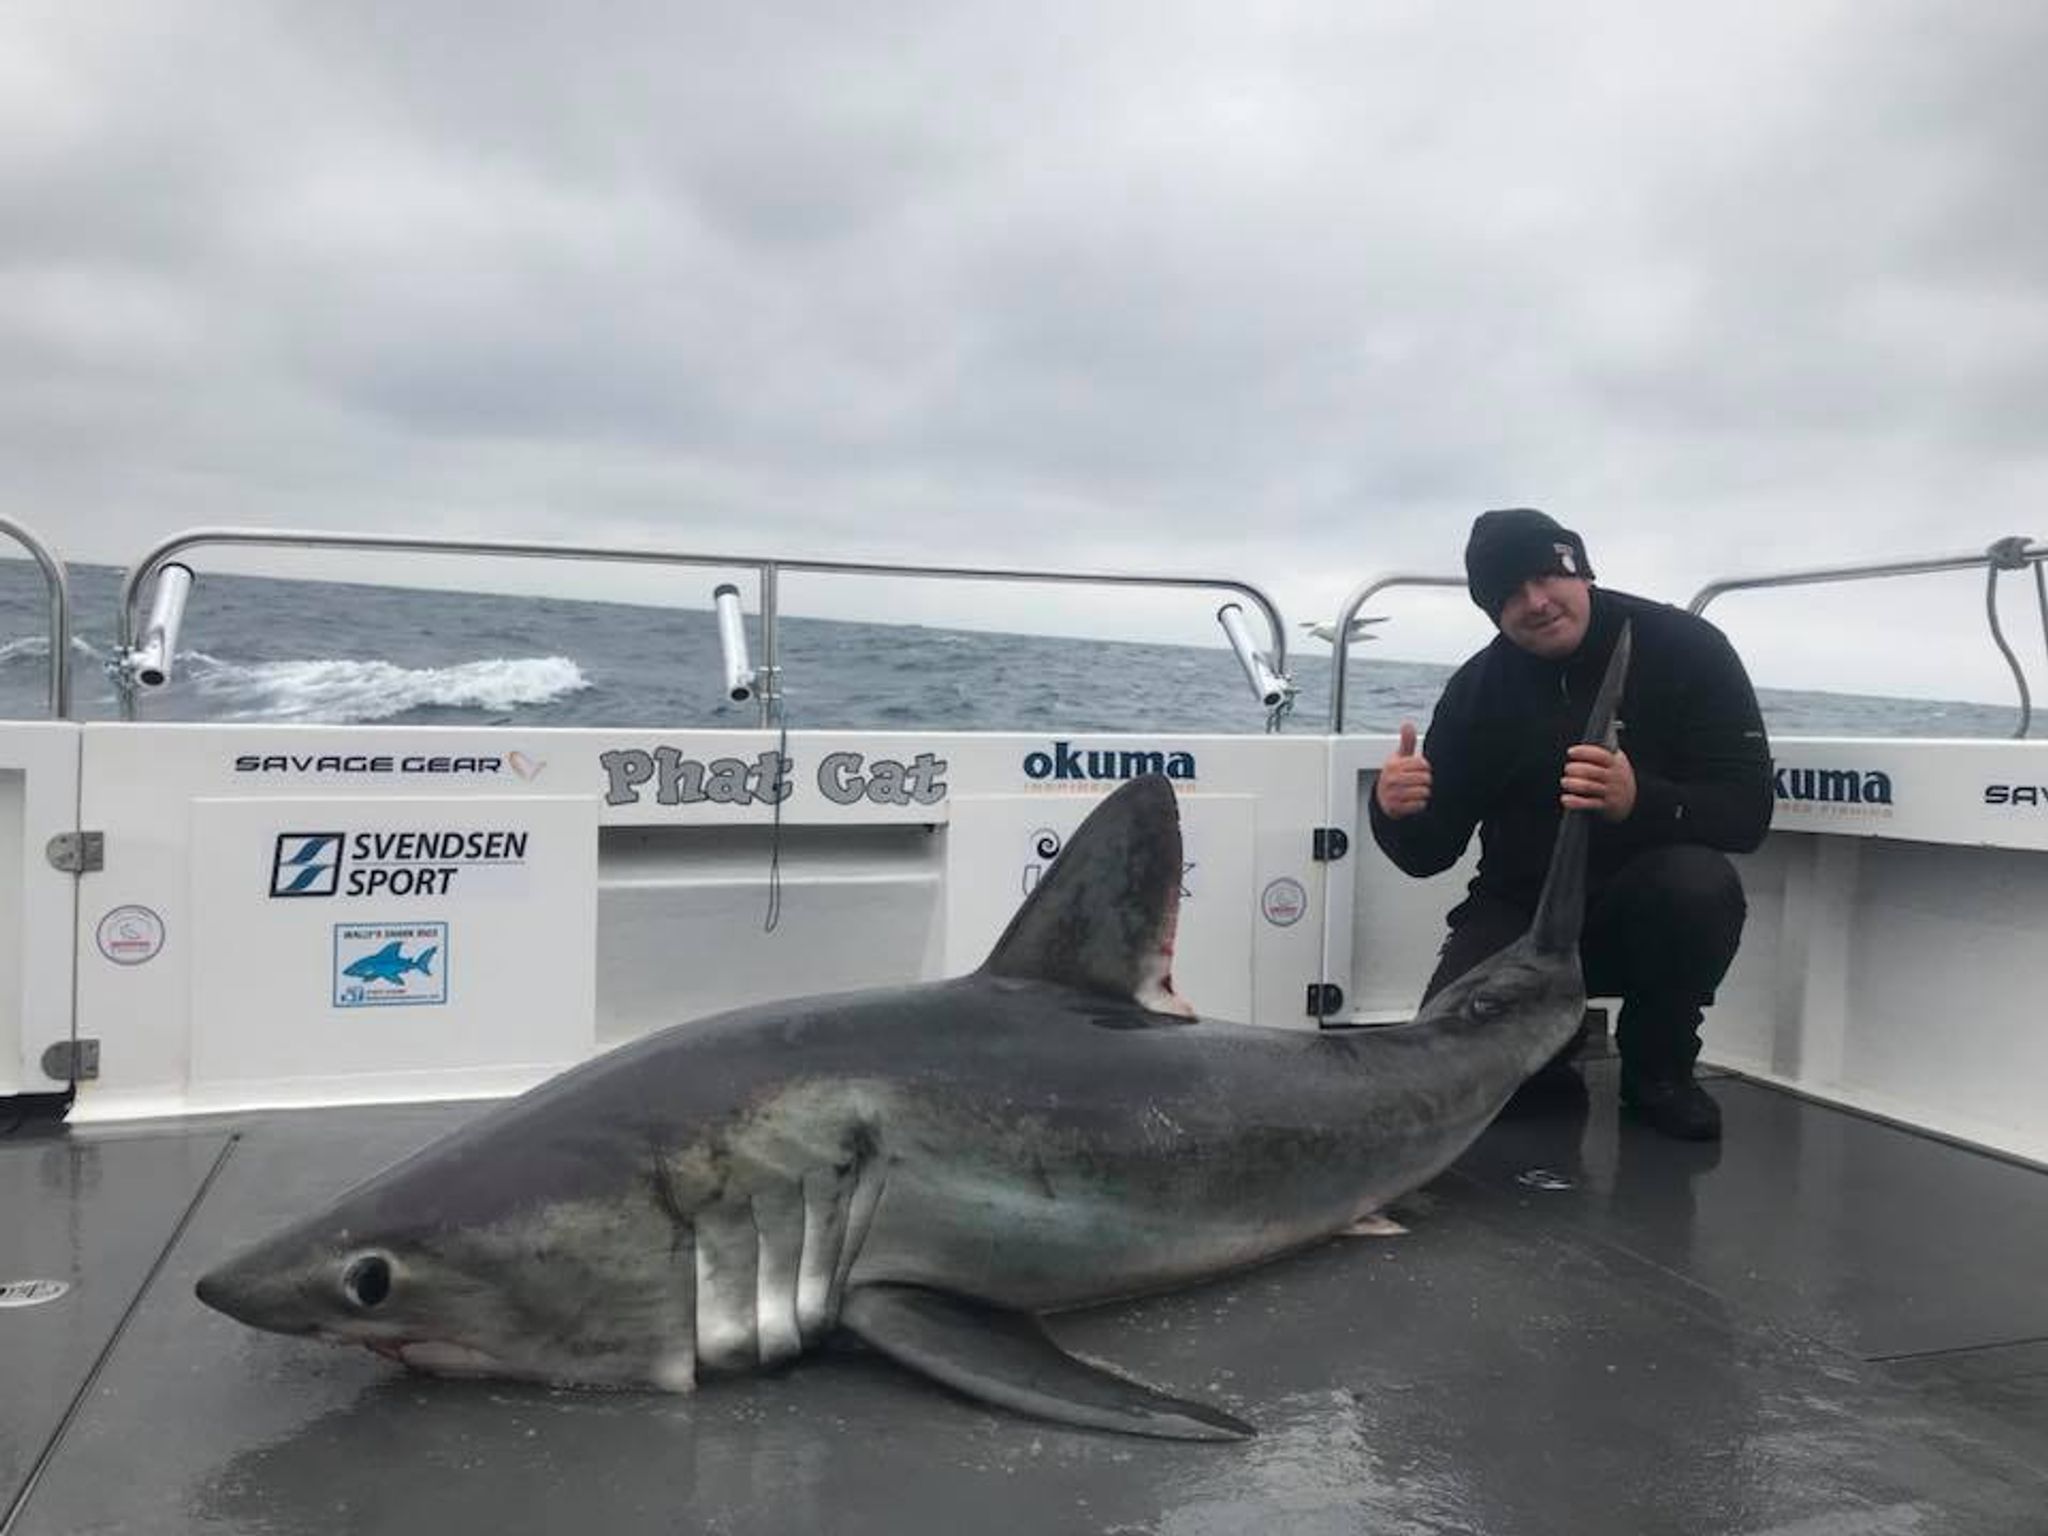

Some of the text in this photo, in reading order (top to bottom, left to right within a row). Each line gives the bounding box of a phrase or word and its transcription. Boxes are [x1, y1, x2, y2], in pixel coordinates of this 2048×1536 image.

[235, 756, 501, 773] SAVAGE GEAR
[600, 746, 947, 805] Phat Cat
[1023, 742, 1196, 779] okuma
[1773, 768, 1893, 805] kuma
[352, 832, 528, 860] SVENDSEN
[346, 868, 458, 896] SPORT
